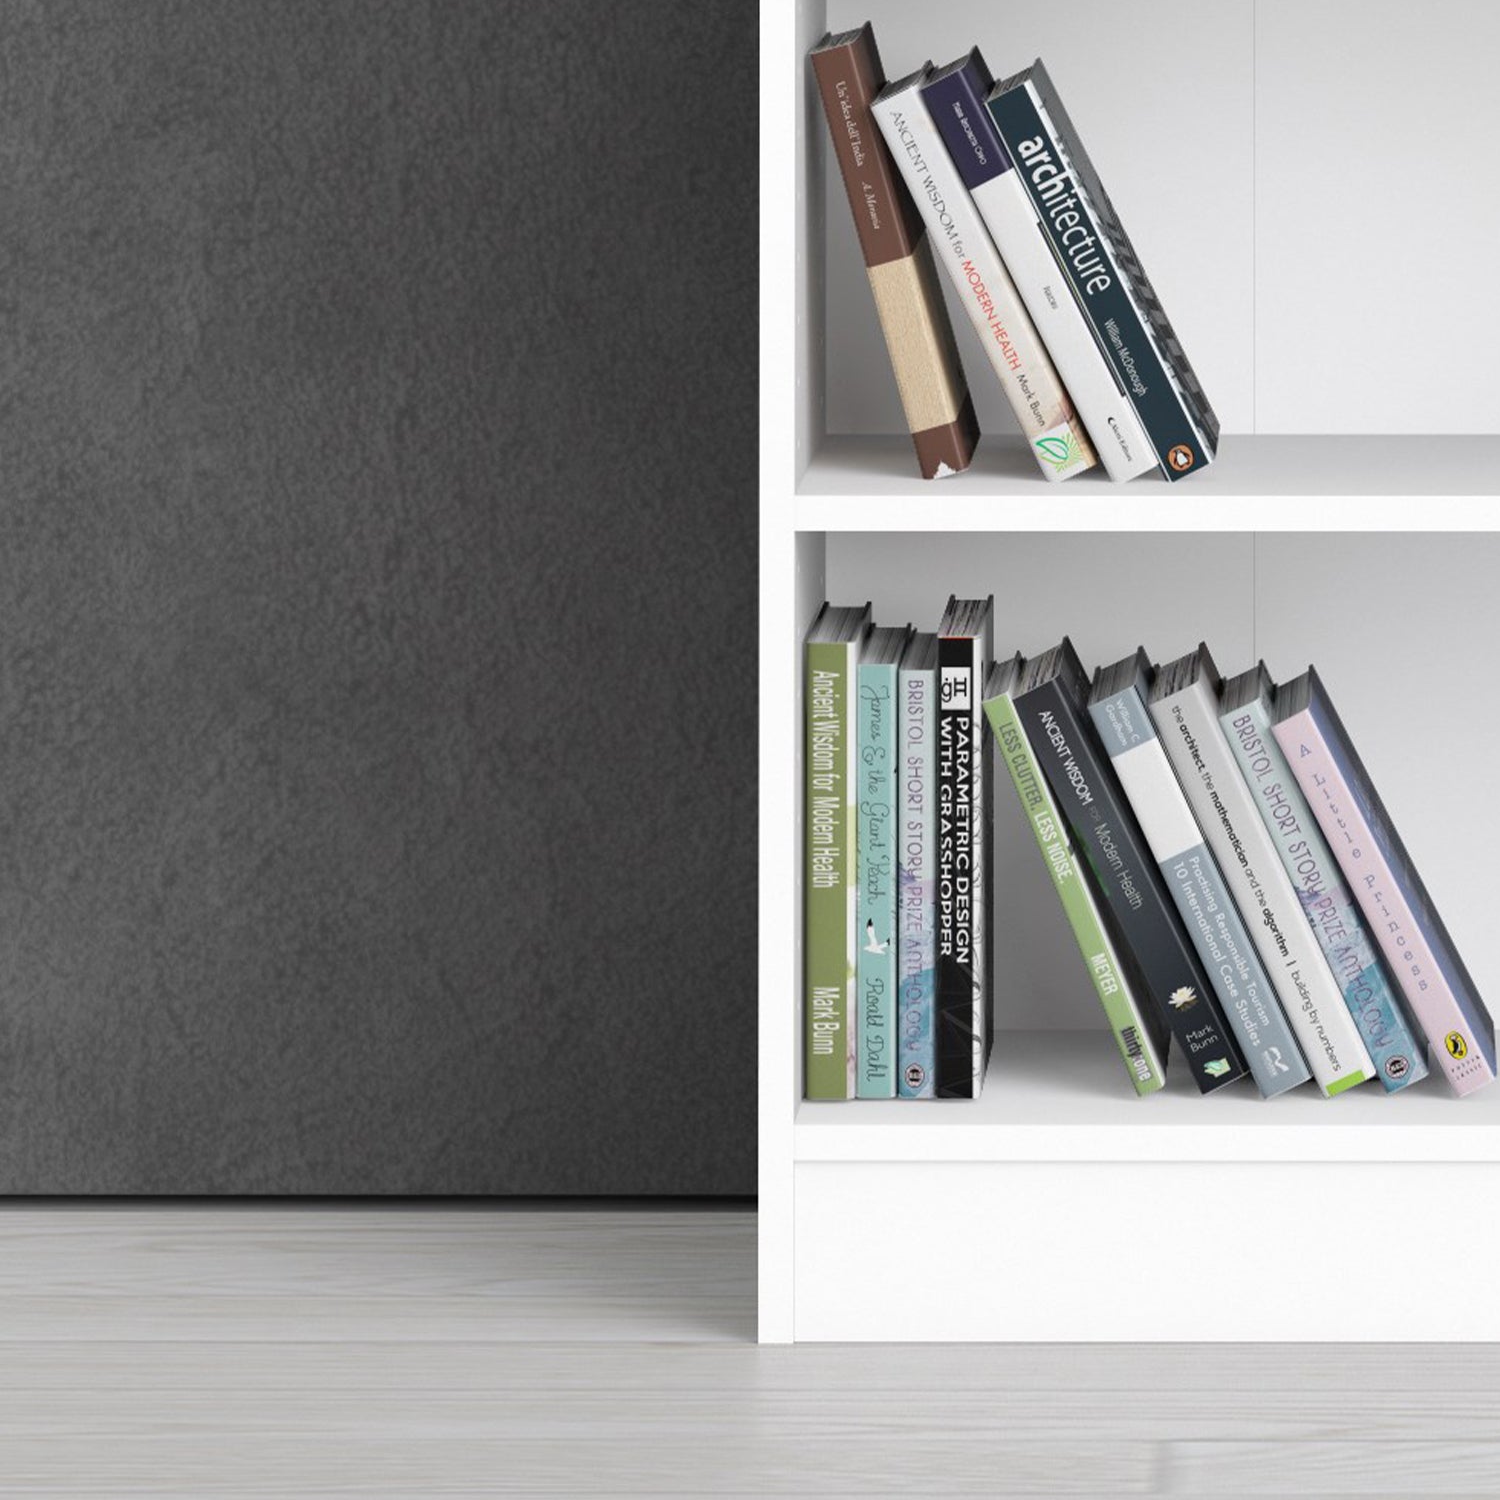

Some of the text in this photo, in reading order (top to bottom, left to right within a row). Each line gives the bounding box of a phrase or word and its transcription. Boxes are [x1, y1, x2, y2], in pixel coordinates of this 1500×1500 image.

[890, 112, 1046, 427] ANCIENT WISDOM for MODERN HEALTH Mark Bunn
[1019, 136, 1110, 293] architecture
[1104, 318, 1123, 349] William
[1115, 347, 1148, 397] McDonough
[859, 684, 891, 741] James
[867, 769, 886, 795] the
[1038, 711, 1072, 757] ANCIENT
[1064, 756, 1093, 805] WISDOM
[1094, 823, 1123, 870] Modern
[1117, 869, 1143, 910] Health
[811, 670, 840, 1055] Ancient Wisdom for Modern Health Mark Bunn
[860, 800, 890, 852] Giant
[905, 679, 924, 1052] BRISTOL SHORT STORY PRIZE ANTHOLOGY
[939, 716, 953, 956] WITH GRASSHOPPER
[955, 716, 970, 964] PARAMETRIC DESIGN
[999, 722, 1022, 755] LESS
[1011, 753, 1043, 811] CLUTTER.
[1033, 811, 1058, 842] LESS
[1046, 843, 1074, 884] NOISE.
[1090, 953, 1119, 996] MEYER
[1171, 705, 1184, 724] the
[1201, 772, 1215, 791] the
[1210, 791, 1248, 868] mathematician
[1244, 868, 1261, 889] and
[1254, 889, 1267, 908] the
[1262, 908, 1289, 957] algorithm
[1291, 970, 1313, 1012] building
[1308, 1009, 1320, 1024] by
[1316, 1025, 1341, 1072] numbers
[1233, 714, 1393, 1050] BRISTOL SHORT STORY PRIZE ANTHOLOGY
[1300, 744, 1428, 991] A Little Princess
[864, 977, 885, 1029] Roald
[1173, 861, 1261, 1047] 10 International Case Studies
[1184, 1023, 1215, 1044] Mark
[1189, 856, 1218, 912] Practising
[1215, 913, 1249, 980] Responsible
[1246, 981, 1270, 1026] Tourism
[1189, 1032, 1220, 1053] Bunn
[864, 1034, 888, 1082] Dahl
